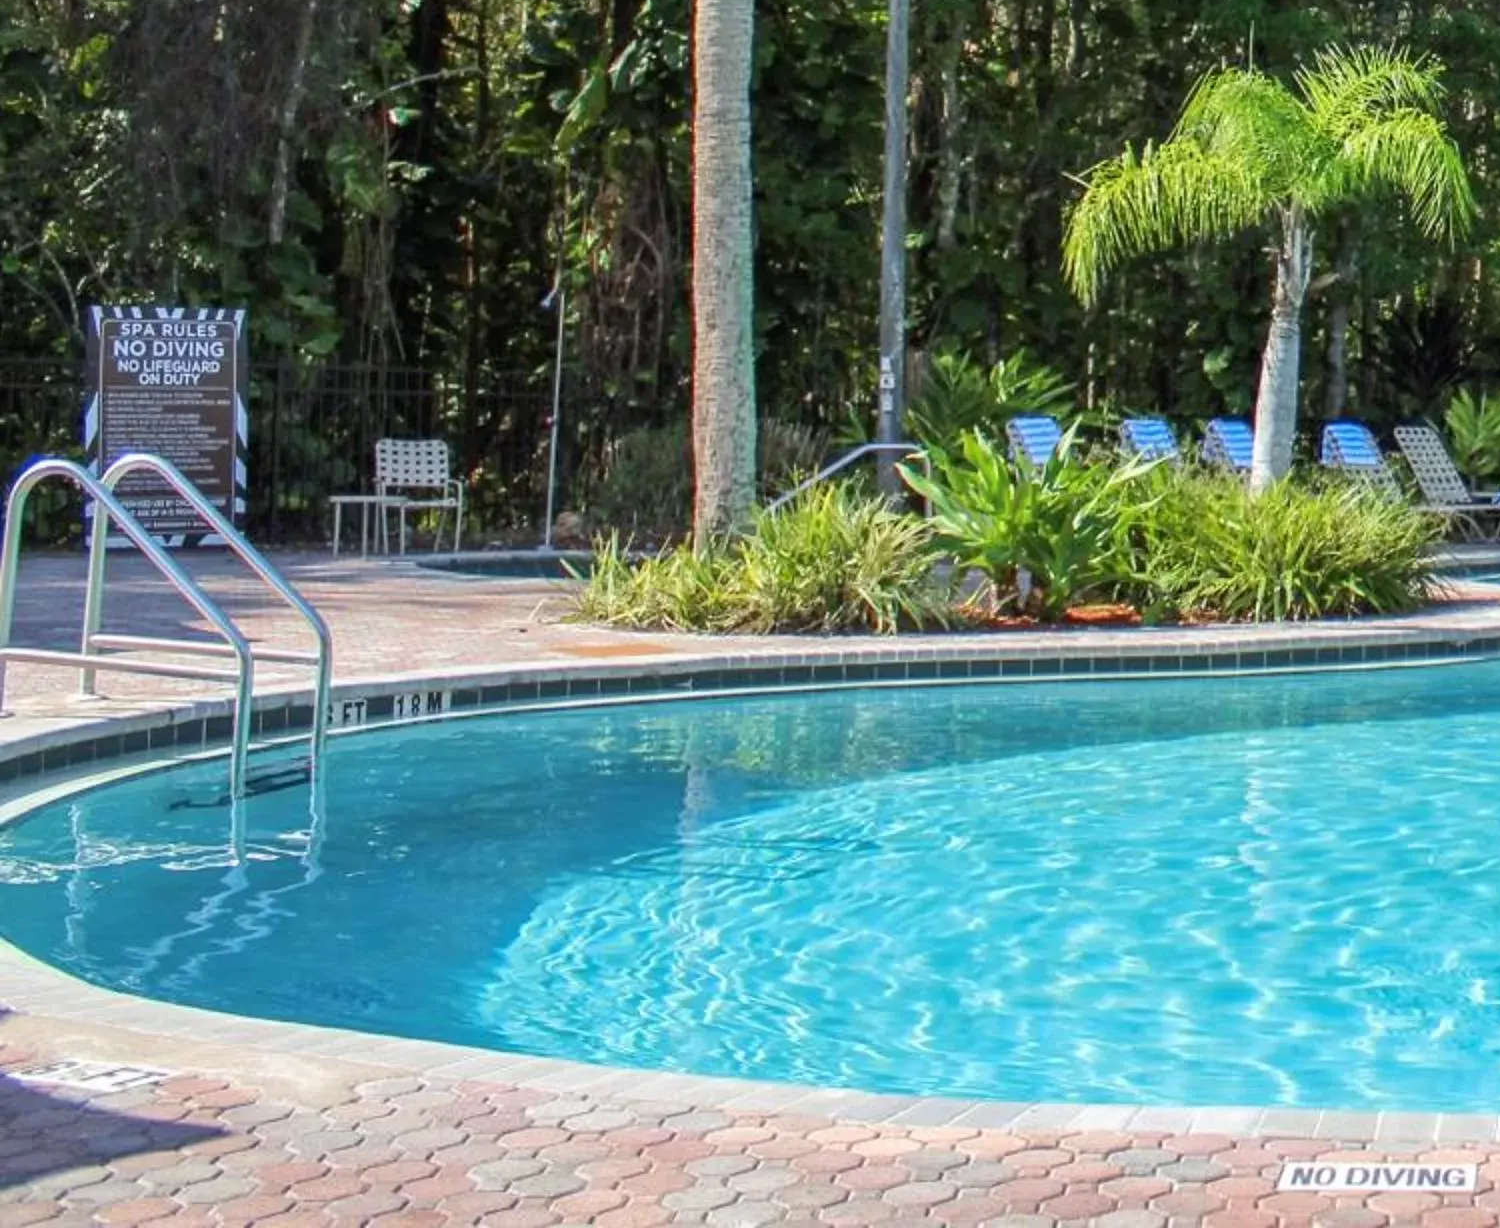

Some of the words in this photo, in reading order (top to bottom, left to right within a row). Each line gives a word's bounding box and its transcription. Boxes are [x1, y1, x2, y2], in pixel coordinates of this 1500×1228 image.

[120, 323, 156, 337] SPA
[161, 323, 217, 338] RULES
[113, 340, 147, 357] NO
[152, 341, 225, 358] DIVING
[117, 359, 140, 372] NO
[143, 359, 221, 373] LIFEGUARD
[139, 373, 161, 385] ON
[163, 373, 201, 385] DUTY
[1289, 1166, 1336, 1186] NO
[1344, 1166, 1467, 1187] DIVING
